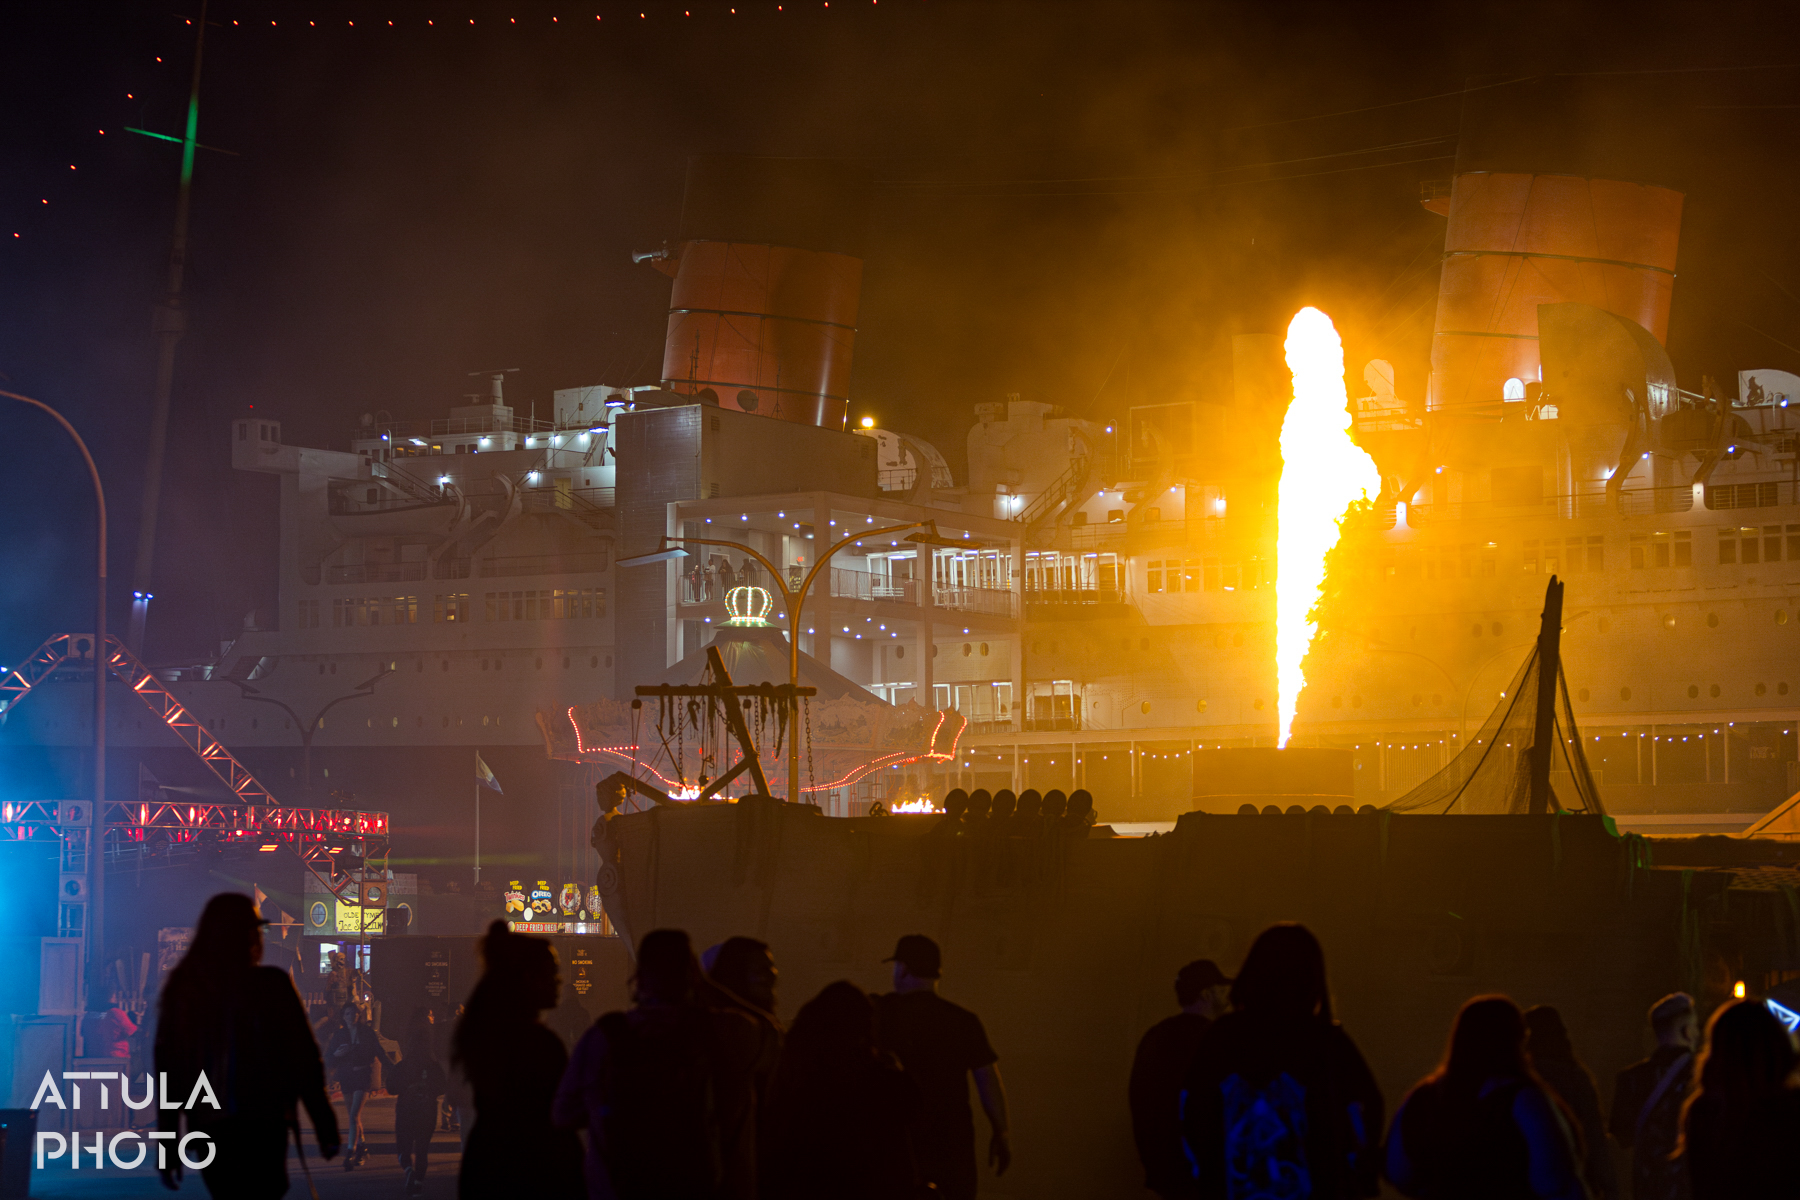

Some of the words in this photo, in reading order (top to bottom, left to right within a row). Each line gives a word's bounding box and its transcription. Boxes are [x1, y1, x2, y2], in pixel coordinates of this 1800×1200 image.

[532, 890, 551, 898] OREO
[516, 923, 529, 932] DEEP
[529, 923, 543, 932] FRIED
[544, 923, 557, 932] OREO
